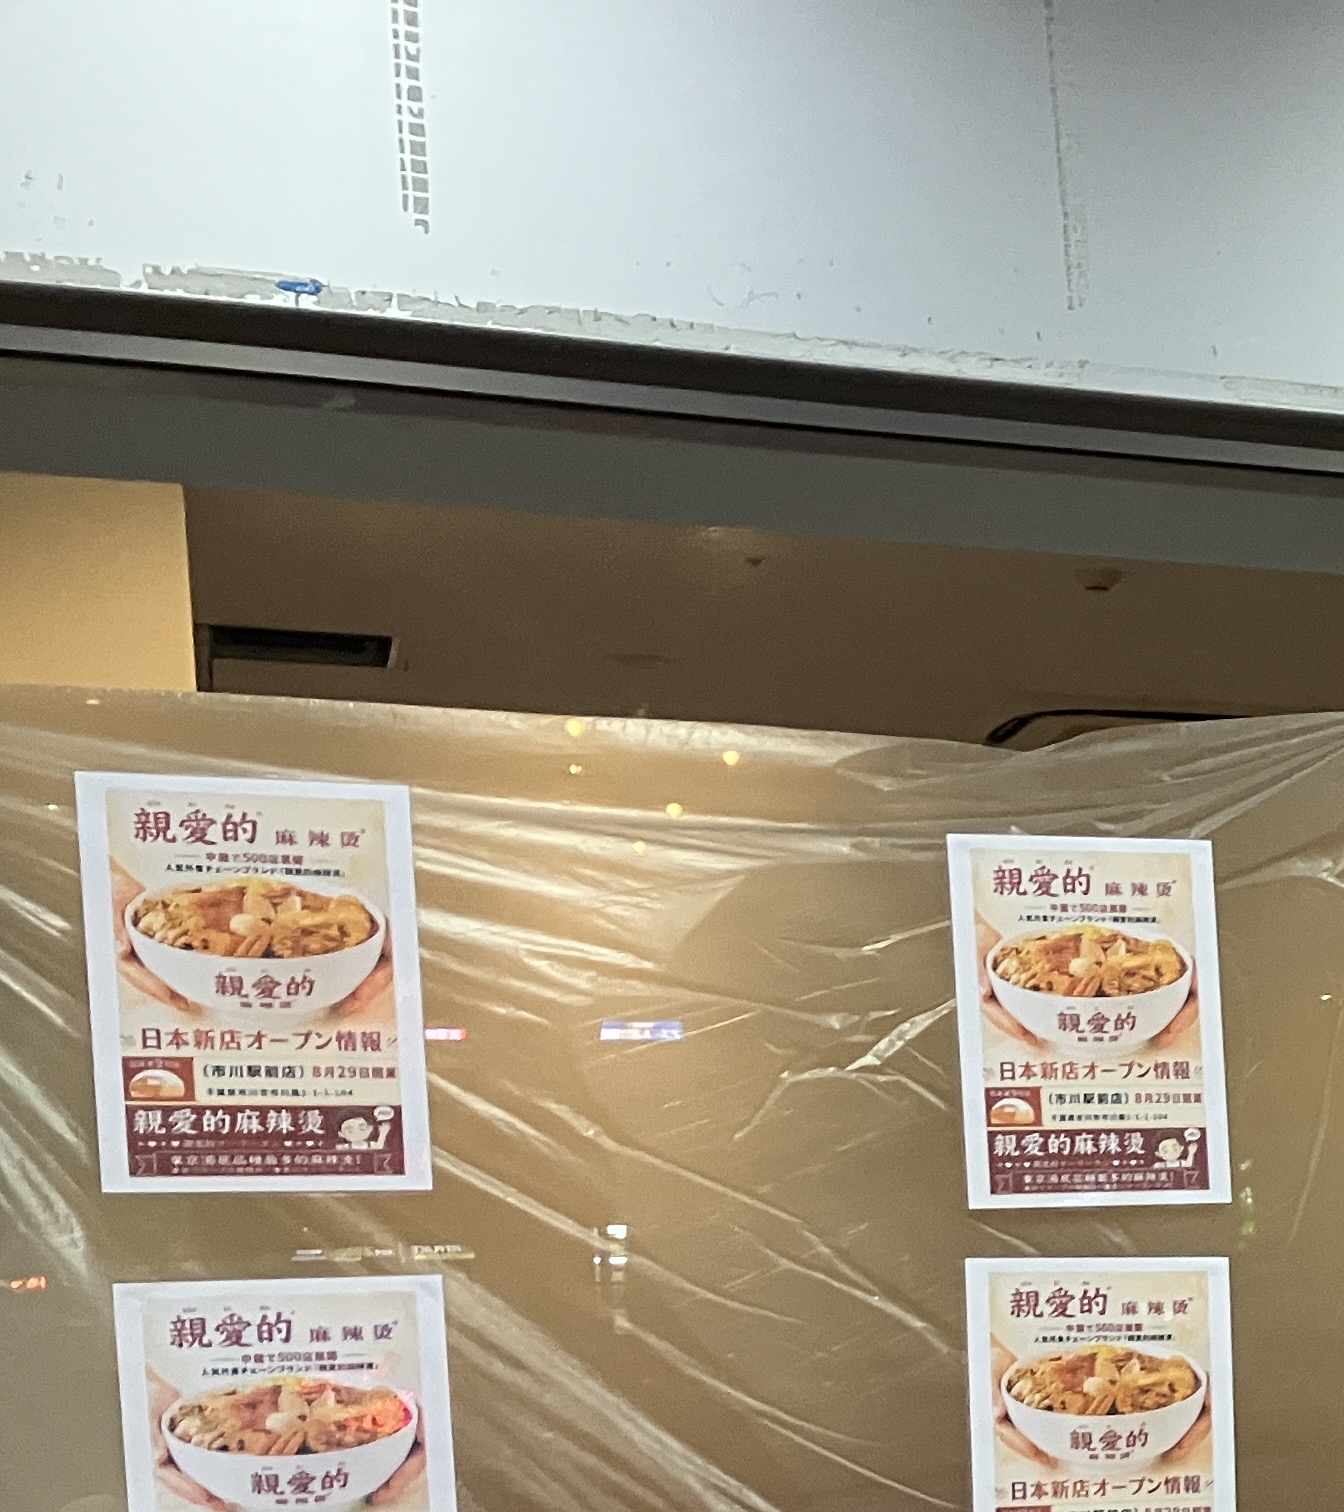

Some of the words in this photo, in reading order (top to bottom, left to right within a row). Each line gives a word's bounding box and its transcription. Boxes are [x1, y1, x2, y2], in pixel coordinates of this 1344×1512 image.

[134, 807, 257, 845] 親愛的
[993, 865, 1091, 897] 親愛的
[215, 973, 316, 999] 親愛的
[1057, 1012, 1137, 1034] 親愛的
[141, 1027, 383, 1052] 日本新店オープン情報
[999, 1061, 1191, 1081] 日本新店オープン情報
[1010, 1287, 1108, 1318] 親愛的
[170, 1311, 292, 1348] 親愛的
[1070, 1429, 1149, 1451] 親愛的
[251, 1469, 350, 1496] 親愛的
[1011, 1475, 1201, 1500] 日本新店オープン情報
